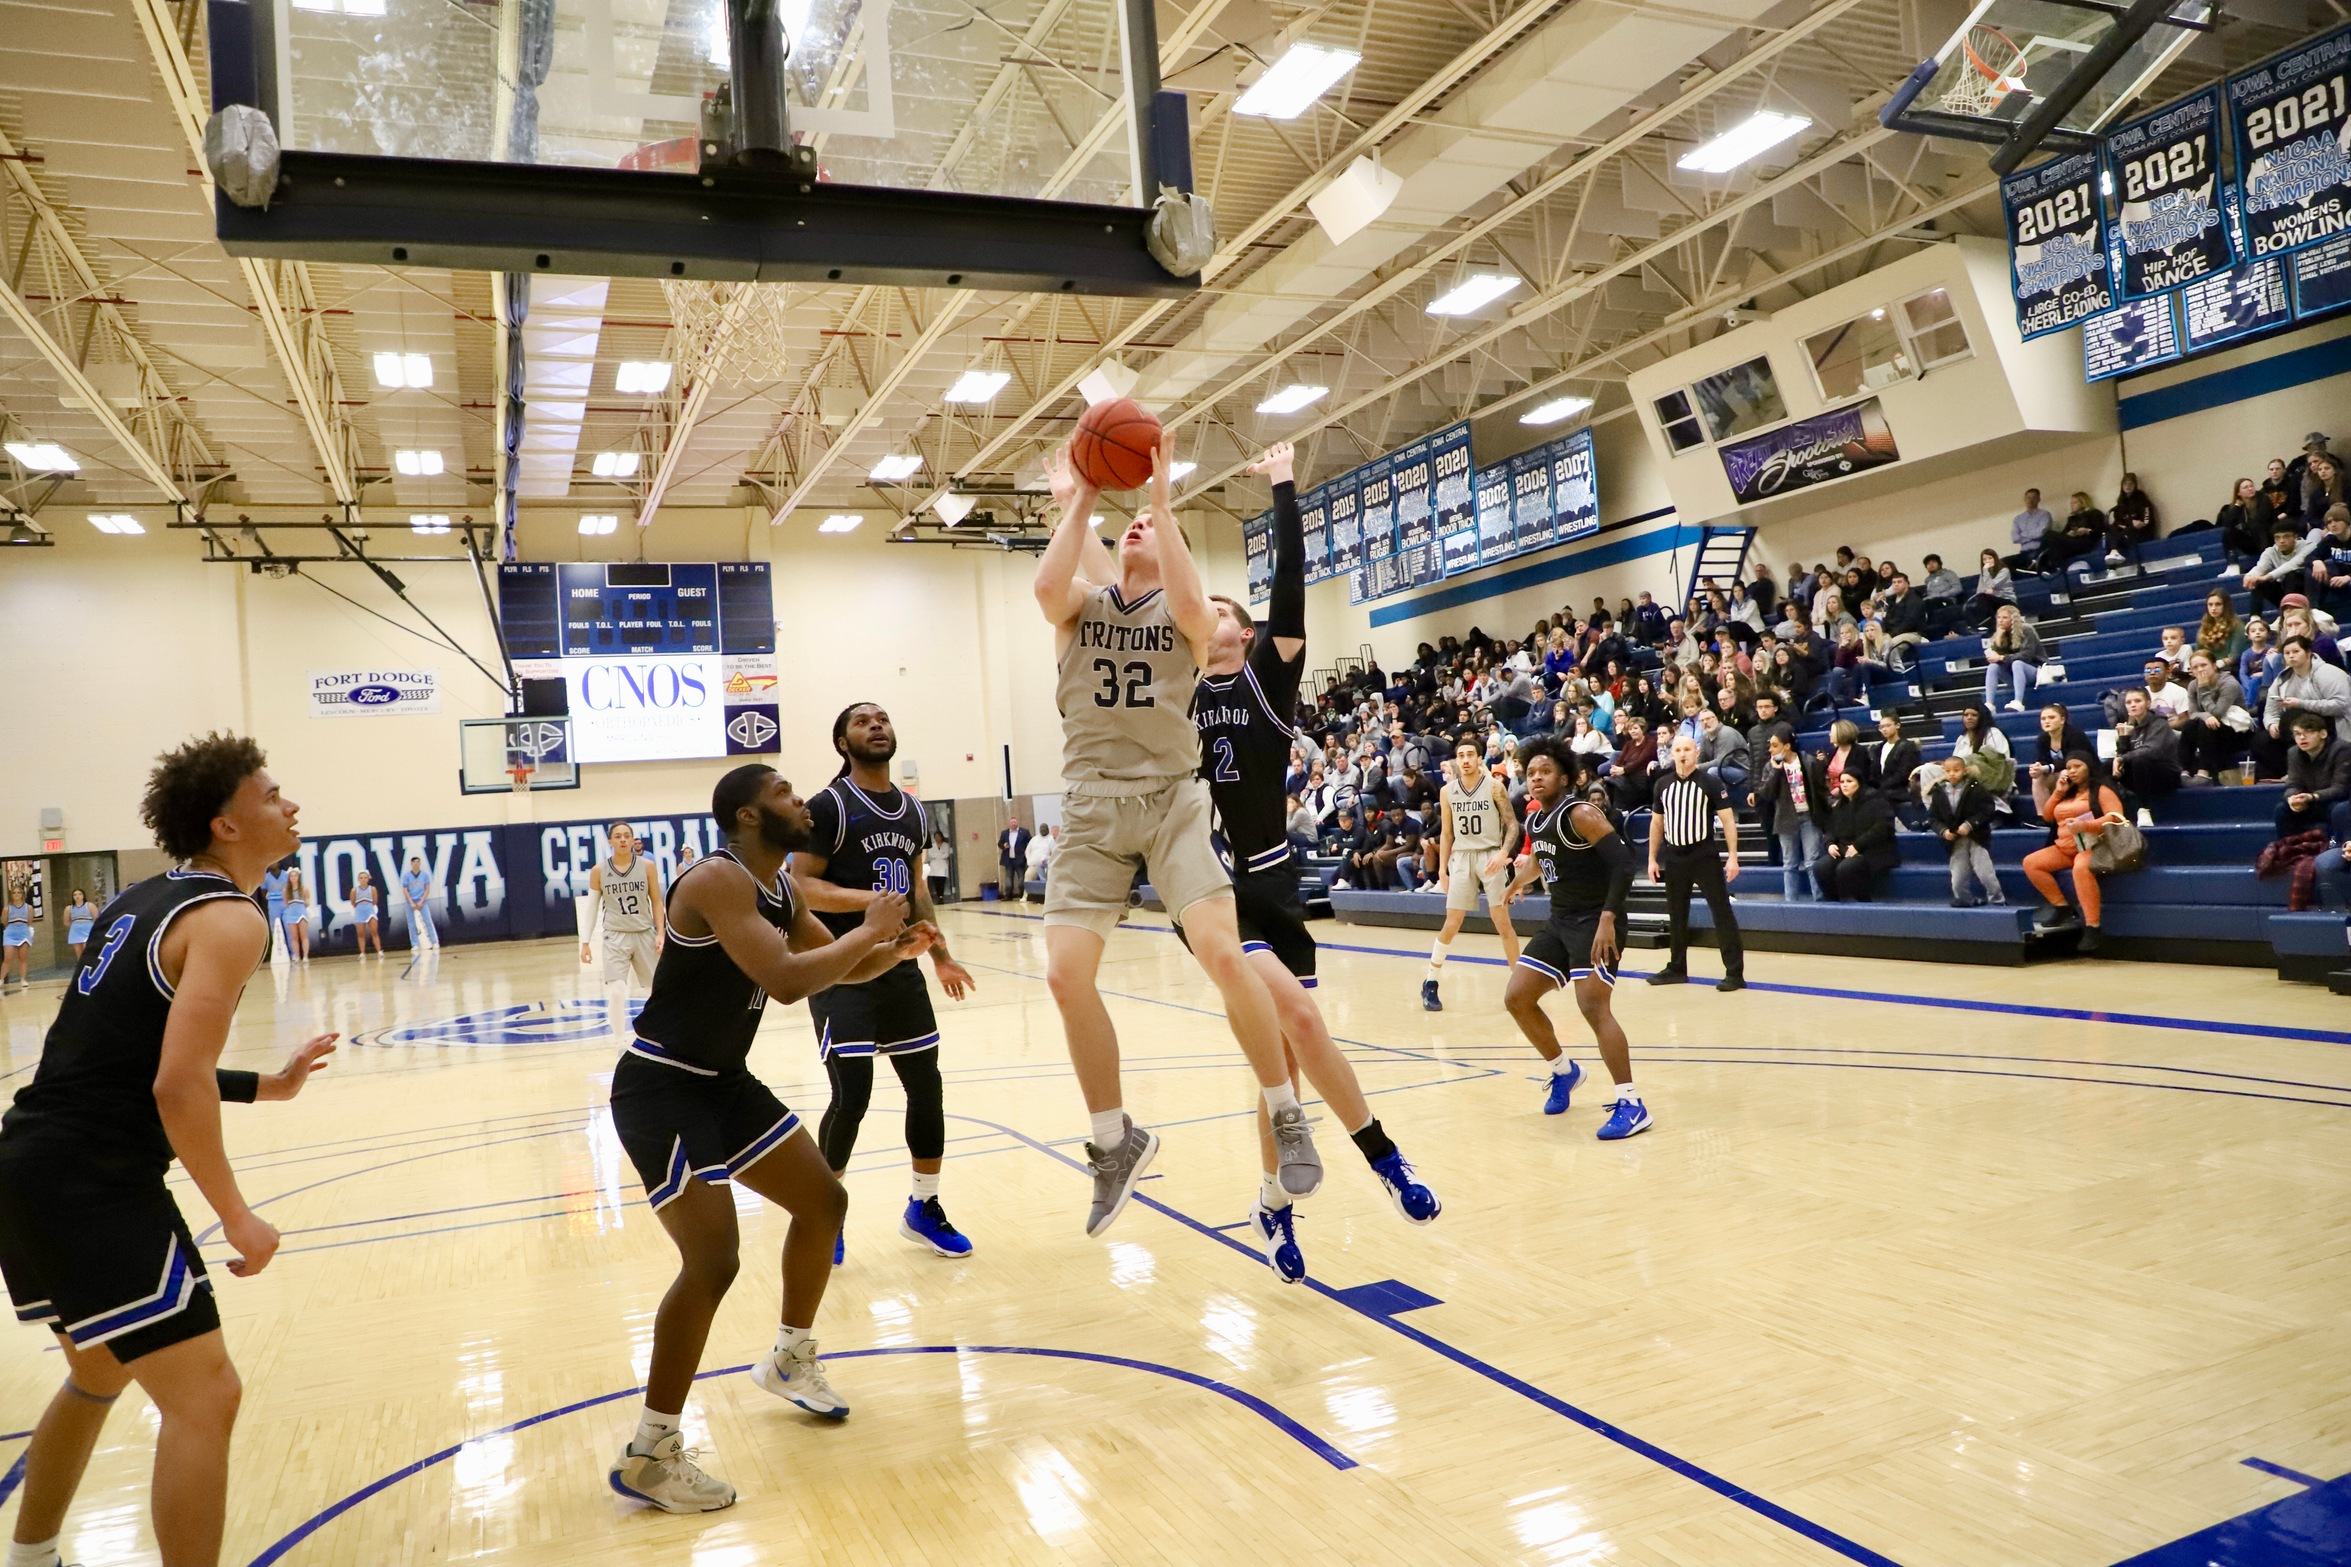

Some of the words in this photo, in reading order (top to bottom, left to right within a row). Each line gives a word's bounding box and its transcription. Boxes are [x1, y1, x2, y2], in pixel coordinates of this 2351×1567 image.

[2231, 69, 2273, 99] IOWA
[2276, 33, 2351, 81] CENTRAL
[2241, 79, 2298, 106] COMMUNITY
[2302, 57, 2348, 81] COLLEGE
[2109, 126, 2146, 153] IOWA
[2149, 96, 2215, 137] CENTRAL
[2247, 75, 2346, 150] 2021
[2118, 134, 2168, 159] COMMUNITY
[2169, 116, 2210, 138] COLLEGE
[2263, 129, 2336, 171] NJCAA
[2004, 175, 2038, 198] IOWA
[2041, 152, 2096, 186] CENTRAL
[2125, 135, 2206, 200] 2021
[2255, 144, 2351, 194] NATIONAL
[2012, 183, 2056, 204] COMMUNITY
[2149, 188, 2189, 216] NDA
[2018, 183, 2091, 243] 2021
[2272, 198, 2341, 233] WOMENS
[2040, 233, 2075, 255] NCA
[2019, 240, 2094, 279] NATIONAL
[2142, 255, 2210, 292] DANCE
[2143, 259, 2168, 275] HIP
[2172, 247, 2198, 265] HOP
[2016, 253, 2106, 298] CHAMPIONS
[2021, 291, 2111, 335] CHEERLEADING
[2027, 297, 2060, 317] LARGE
[2062, 283, 2097, 305] CO-ED
[1445, 425, 1469, 444] CENTRAL
[1406, 443, 1428, 460] CENTRAL
[1436, 445, 1469, 478] 2020
[1555, 450, 1589, 481] 2007
[1724, 443, 1773, 494] GREAT
[1776, 408, 1865, 451] WESTERN
[1758, 434, 1856, 495] Shootout
[1398, 462, 1428, 493] 2020
[1515, 466, 1548, 495] 2006
[1332, 494, 1356, 520] 2019
[1364, 478, 1389, 507] 2019
[1478, 481, 1510, 510] 2002
[1302, 507, 1325, 533] 2019
[1557, 515, 1597, 535] WRESTLING
[1247, 532, 1267, 556] 2019
[1369, 545, 1390, 560] RUGBY
[1401, 531, 1432, 549] BOWLING
[1481, 540, 1516, 559] WRESTLING
[1518, 529, 1554, 548] WRESTLING
[1335, 556, 1361, 573] BOWLING
[1446, 552, 1478, 570] WRESTLING
[571, 588, 599, 598] HOME
[677, 587, 706, 597] GUEST
[568, 621, 590, 629] FOULS
[595, 621, 614, 629] T.O.L.
[646, 620, 663, 628] FOUL
[668, 620, 686, 628] T.O.L.
[691, 620, 712, 628] FOULS
[1079, 620, 1175, 652] TRITONS
[568, 647, 591, 655] SCORE
[314, 673, 363, 689] FORT
[369, 672, 434, 686] DODGE
[581, 662, 707, 711] CNOS
[1092, 657, 1155, 709] 32
[357, 688, 391, 703] Ford
[320, 708, 356, 716] LINCOLN
[1213, 736, 1240, 783] 2
[1452, 800, 1490, 813] TRITONS
[1458, 814, 1483, 836] 30
[46, 840, 63, 852] EXIT
[860, 831, 916, 856] KIRKWOOD
[296, 830, 506, 920] IOWA
[604, 880, 646, 895] TRITONS
[872, 857, 910, 896] 30
[617, 895, 639, 915] 12
[78, 913, 136, 996] 3
